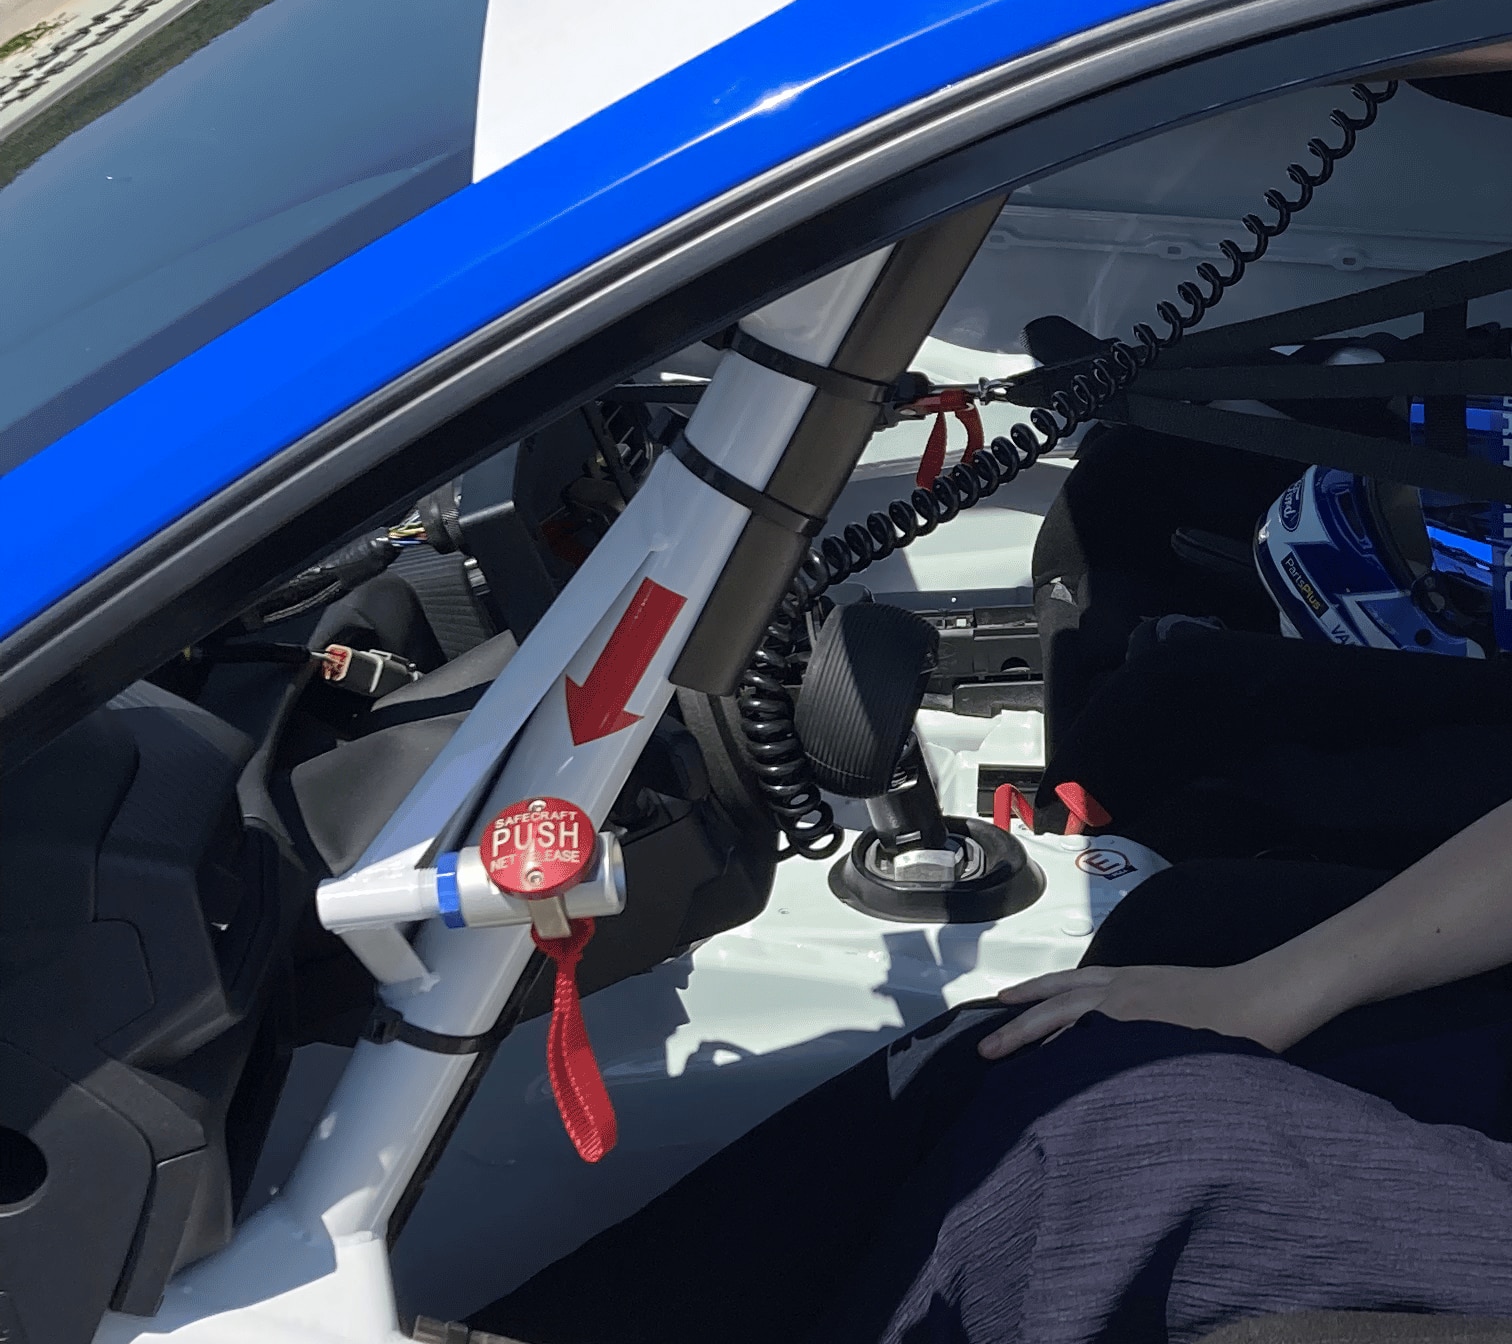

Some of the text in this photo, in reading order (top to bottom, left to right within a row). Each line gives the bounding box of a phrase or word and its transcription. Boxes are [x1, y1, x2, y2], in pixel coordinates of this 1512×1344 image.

[1285, 558, 1322, 610] PartsPlus
[495, 811, 578, 829] SAFECRAFT
[492, 821, 579, 857] PUSH
[490, 854, 516, 873] NET
